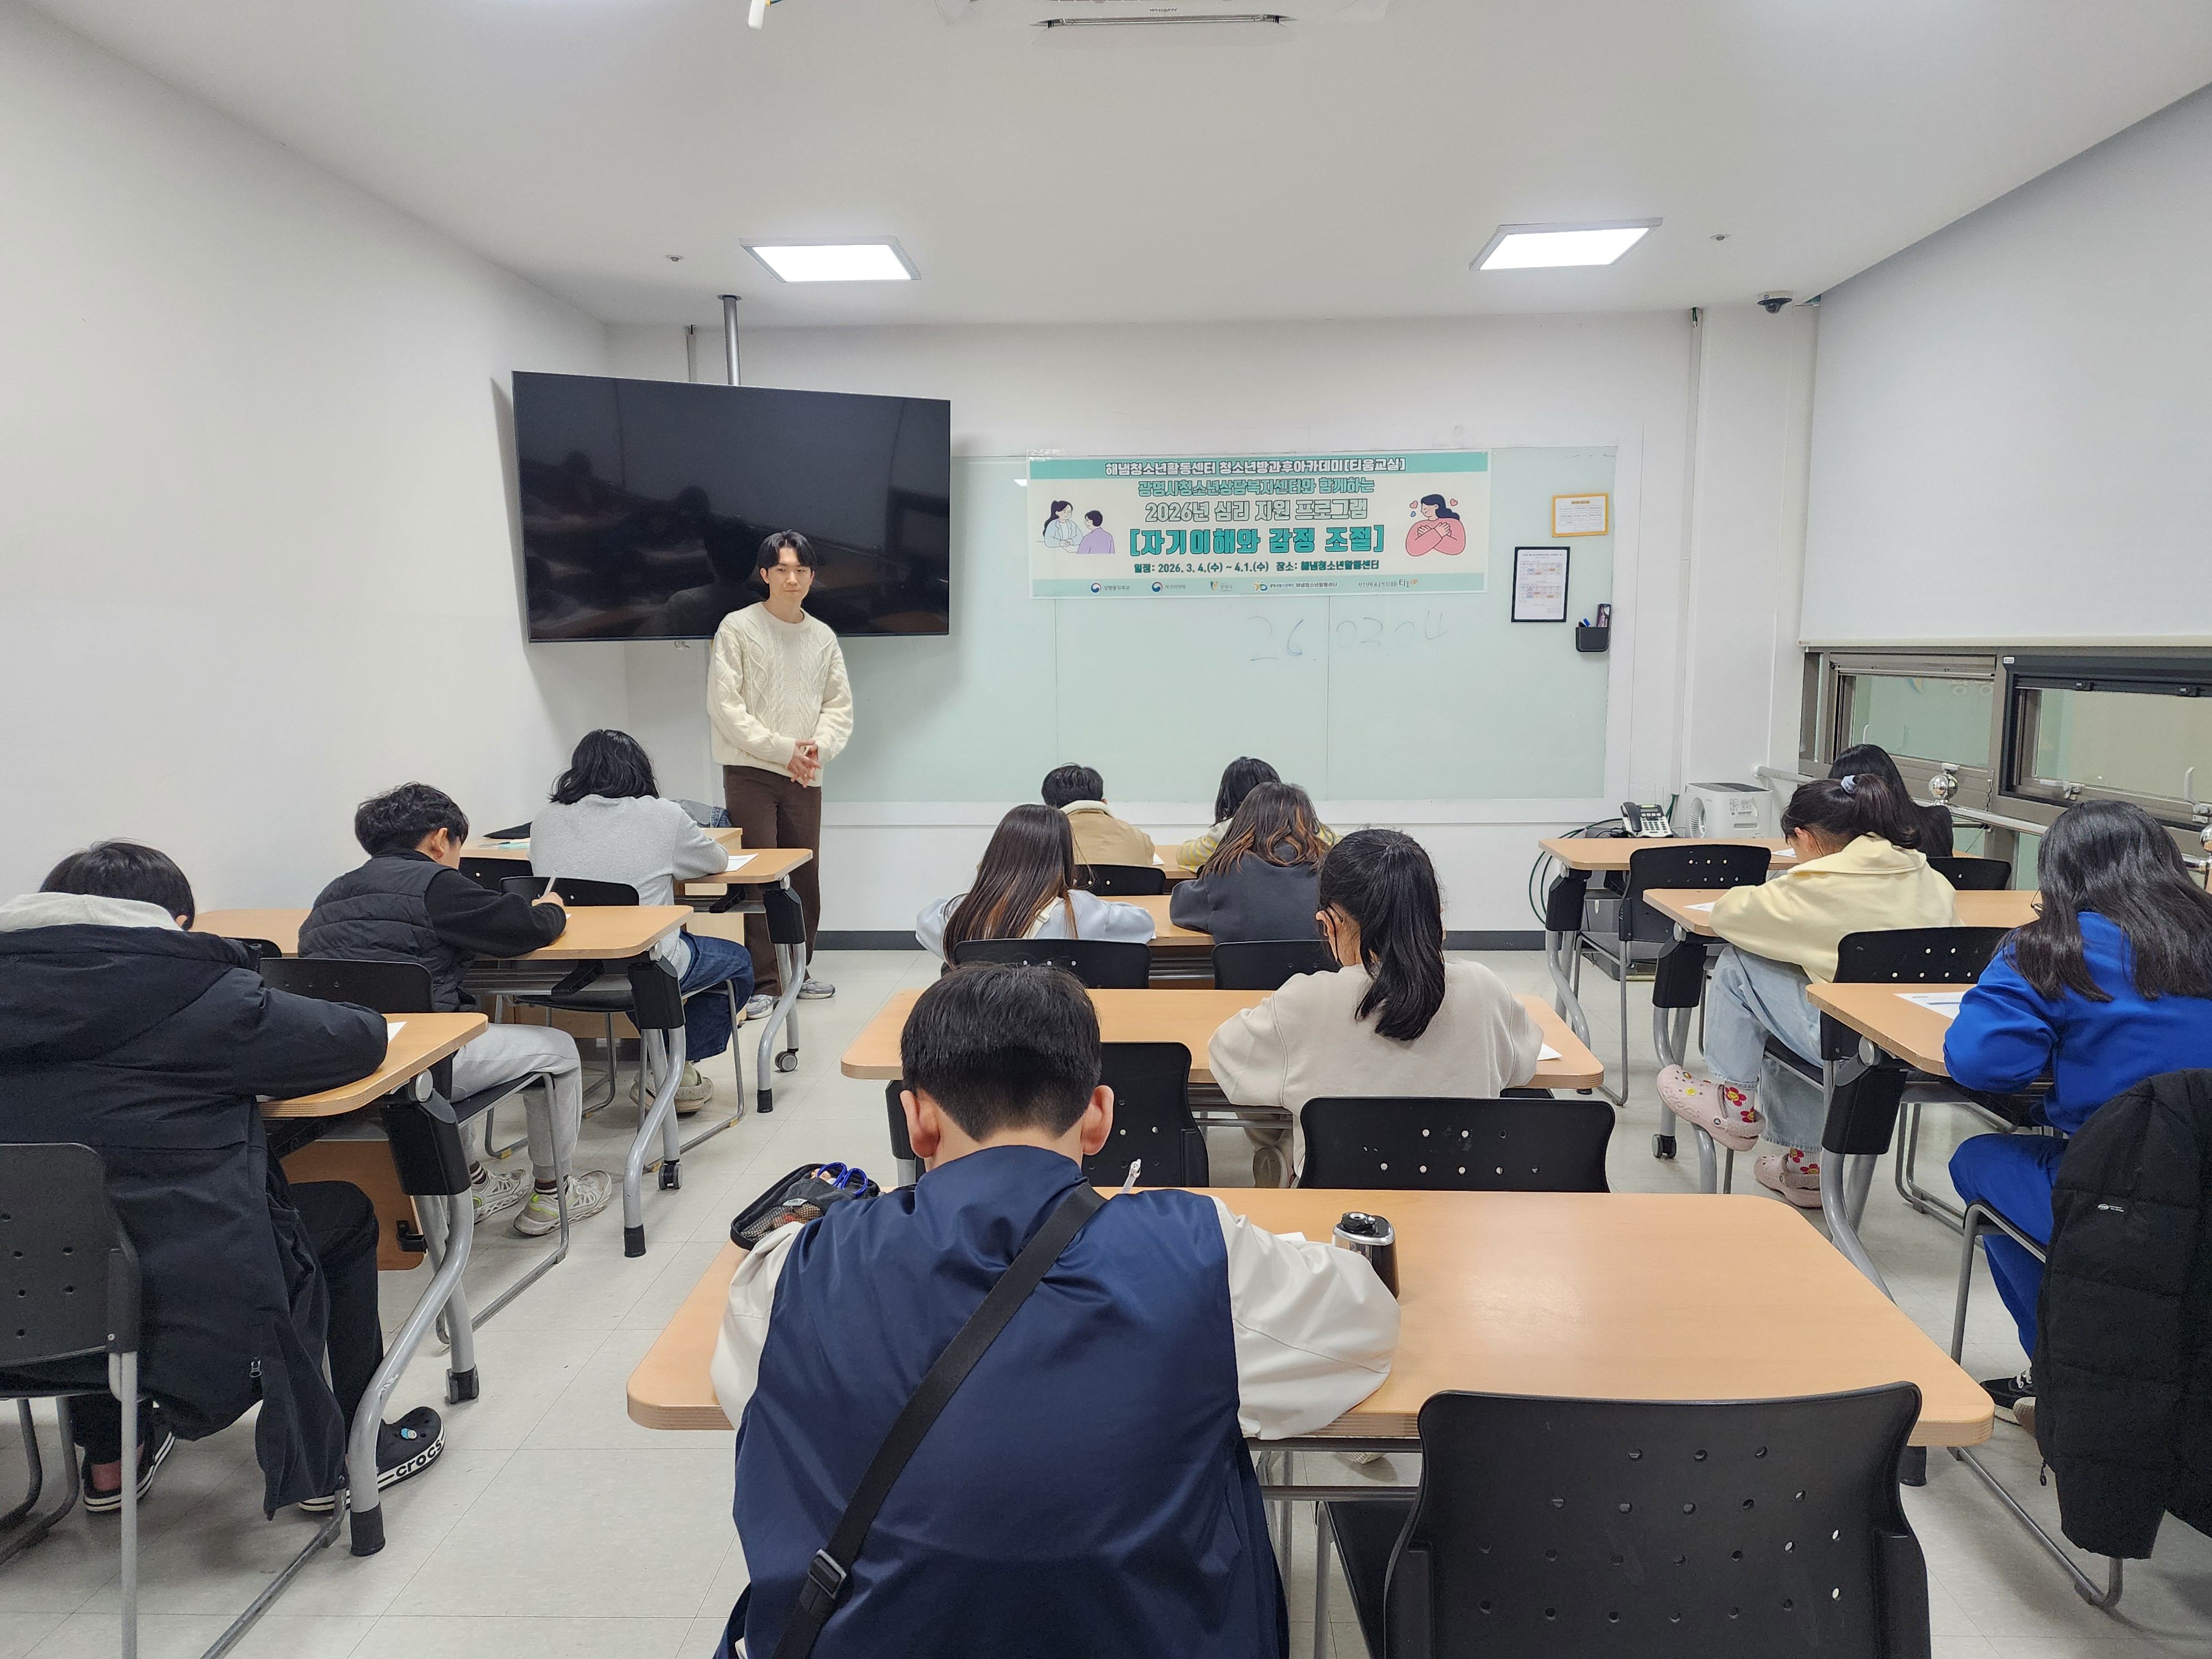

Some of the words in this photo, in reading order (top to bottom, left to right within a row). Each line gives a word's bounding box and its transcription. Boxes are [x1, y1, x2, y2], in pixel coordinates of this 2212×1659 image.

[1105, 461, 1217, 476] 해냄청소년활동센터
[1219, 457, 1406, 475] 청소년방과후아카데미[티움교실]
[1138, 478, 1317, 497] 광명시청소년상담복지센터와
[1318, 476, 1375, 494] 함께하는
[1145, 501, 1209, 522] 2026년
[1214, 500, 1250, 522] 심리
[1255, 499, 1291, 521] 지원
[1295, 498, 1368, 520] 프로그램
[1130, 528, 1261, 556] [자기이해와
[1269, 527, 1315, 553] 감정
[1324, 524, 1385, 552] 조절]
[1134, 563, 1155, 573] 일정:
[1158, 563, 1184, 573] 2026.
[1186, 563, 1195, 573] 3.
[1234, 561, 1269, 572] 4.1.(수)
[1276, 561, 1298, 571] 장소:
[1301, 560, 1379, 571] 해냄청소년활동센터
[396, 1439, 441, 1477] crocs
